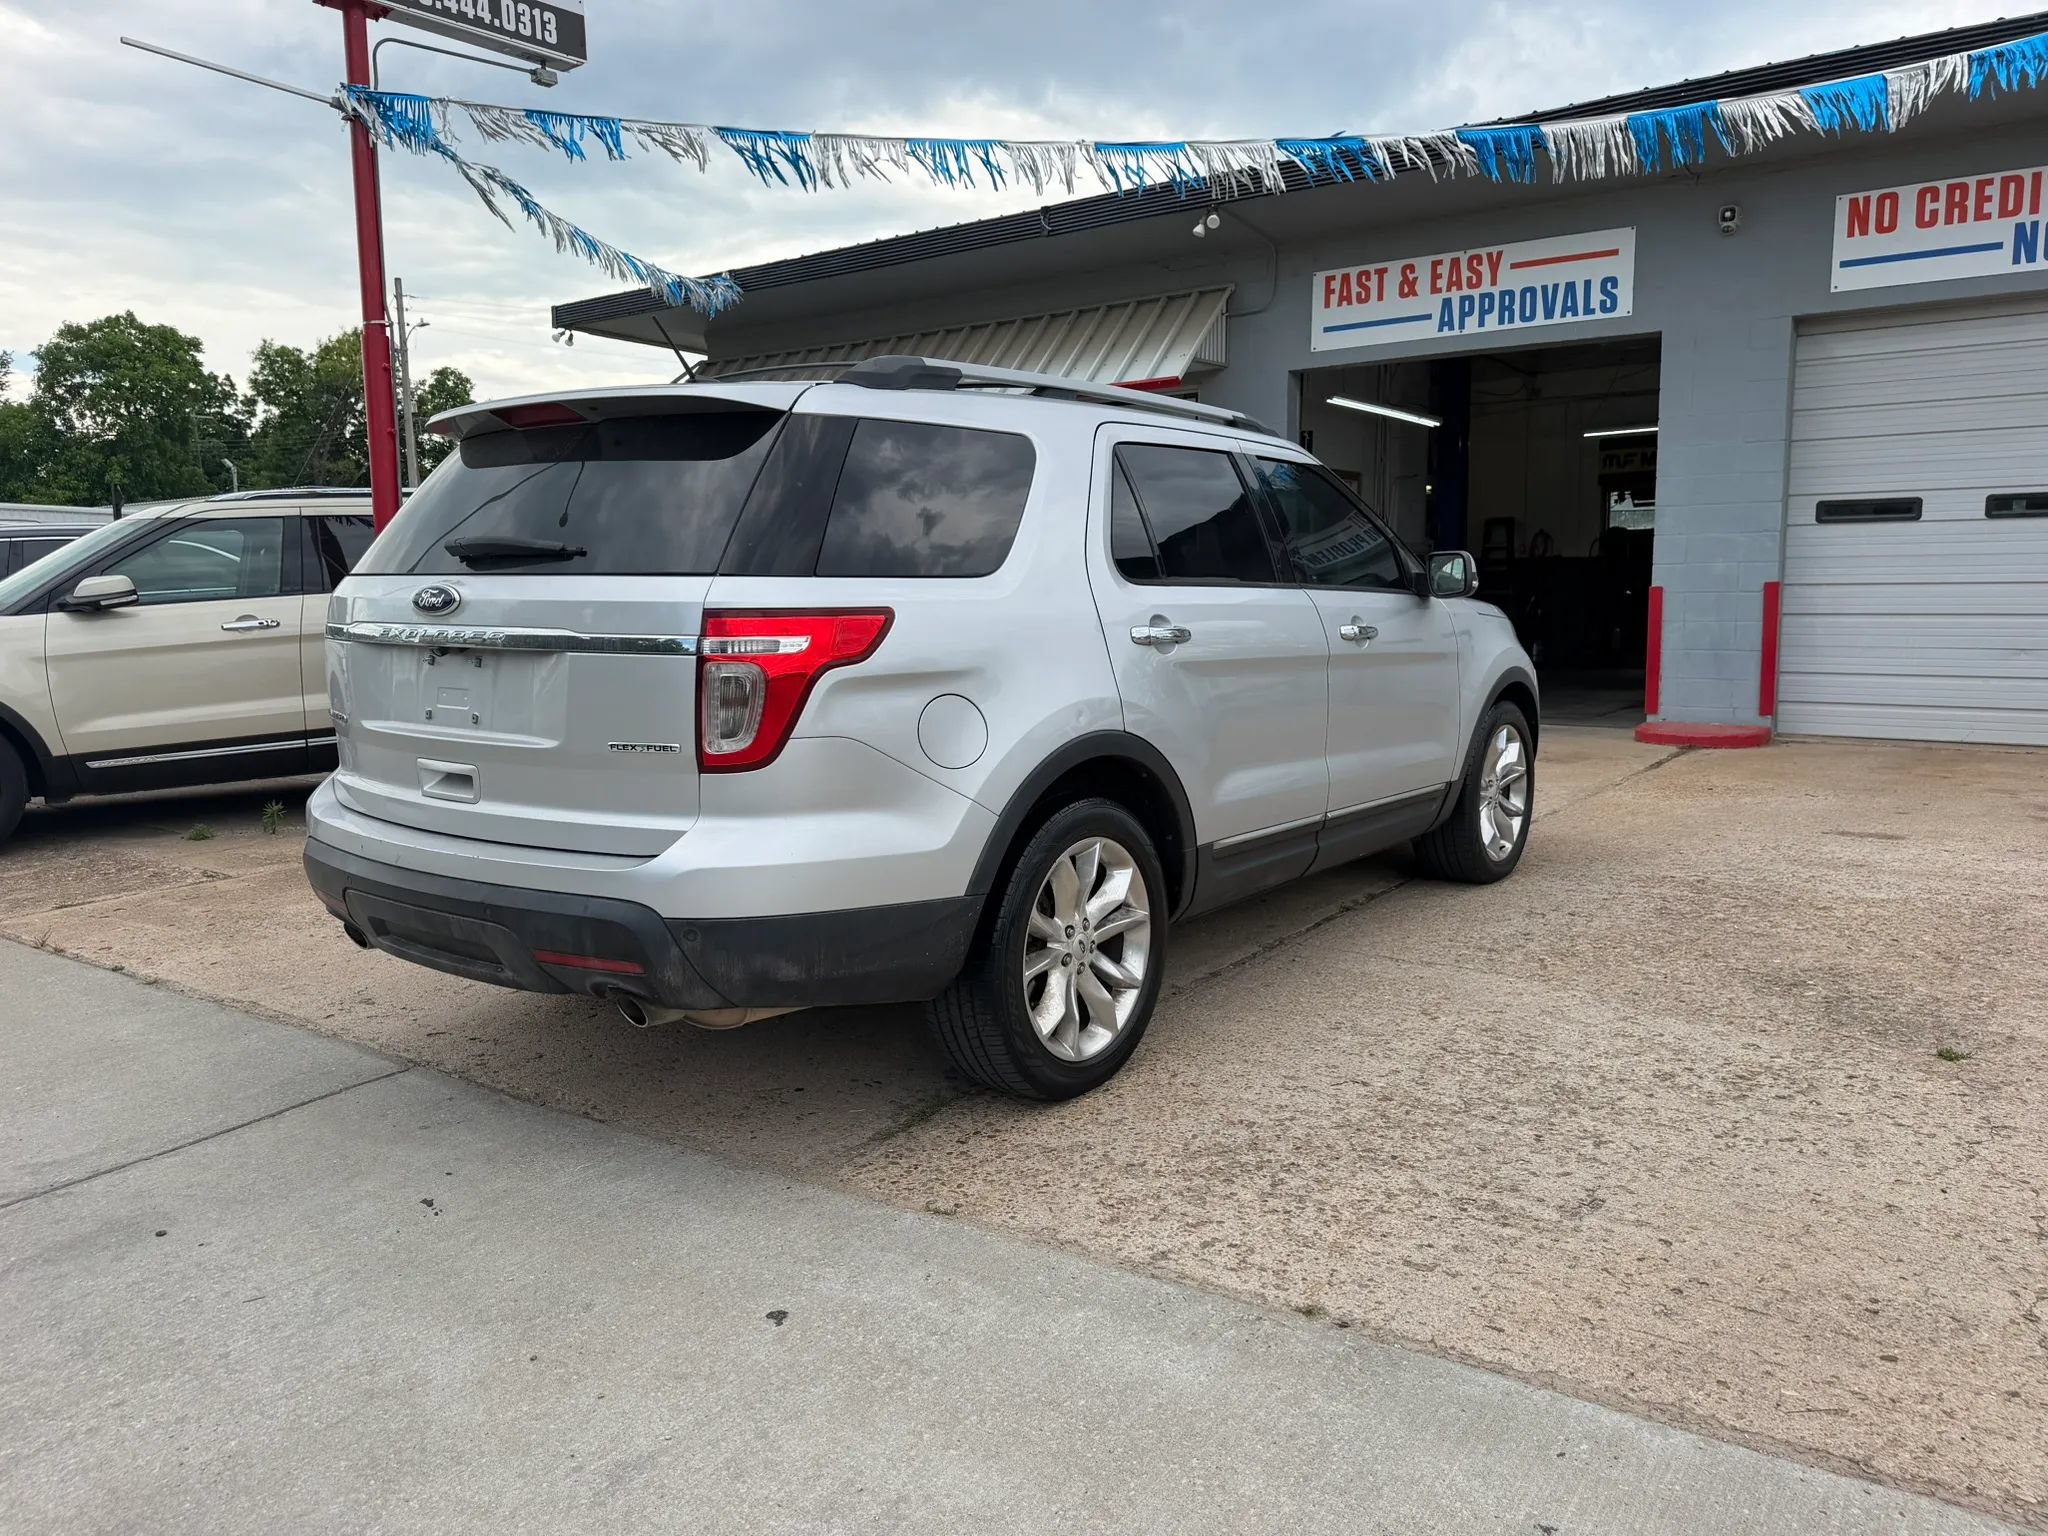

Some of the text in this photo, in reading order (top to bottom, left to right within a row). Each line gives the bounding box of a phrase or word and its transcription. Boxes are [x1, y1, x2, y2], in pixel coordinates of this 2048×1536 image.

[419, 0, 558, 45] .44.0313
[1847, 171, 2048, 238] NO CREDI
[2012, 220, 2048, 265] N
[1324, 250, 1504, 309] FAST & EASY
[1437, 276, 1619, 332] APPROVALS
[610, 743, 679, 752] FLEX FUEL
